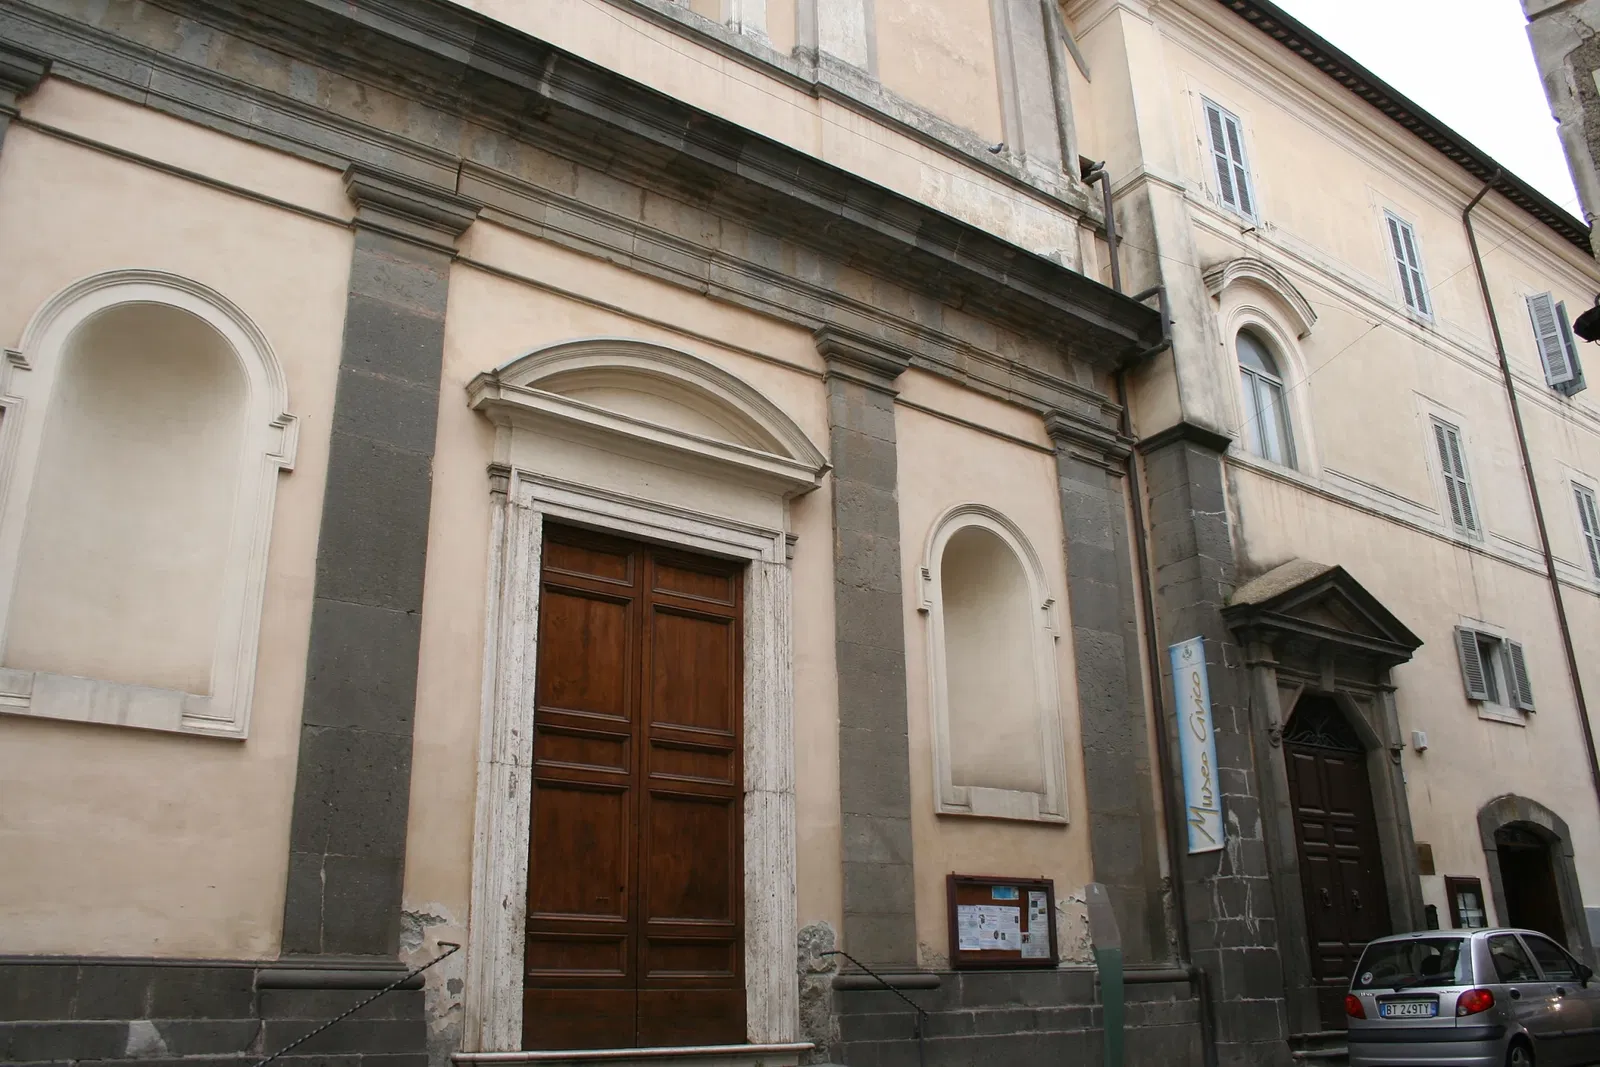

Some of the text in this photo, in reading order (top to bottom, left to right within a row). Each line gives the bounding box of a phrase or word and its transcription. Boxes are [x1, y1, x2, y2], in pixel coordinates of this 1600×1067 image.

[1188, 671, 1219, 844] Museo Civico
[1386, 1003, 1429, 1015] BT 249TY
